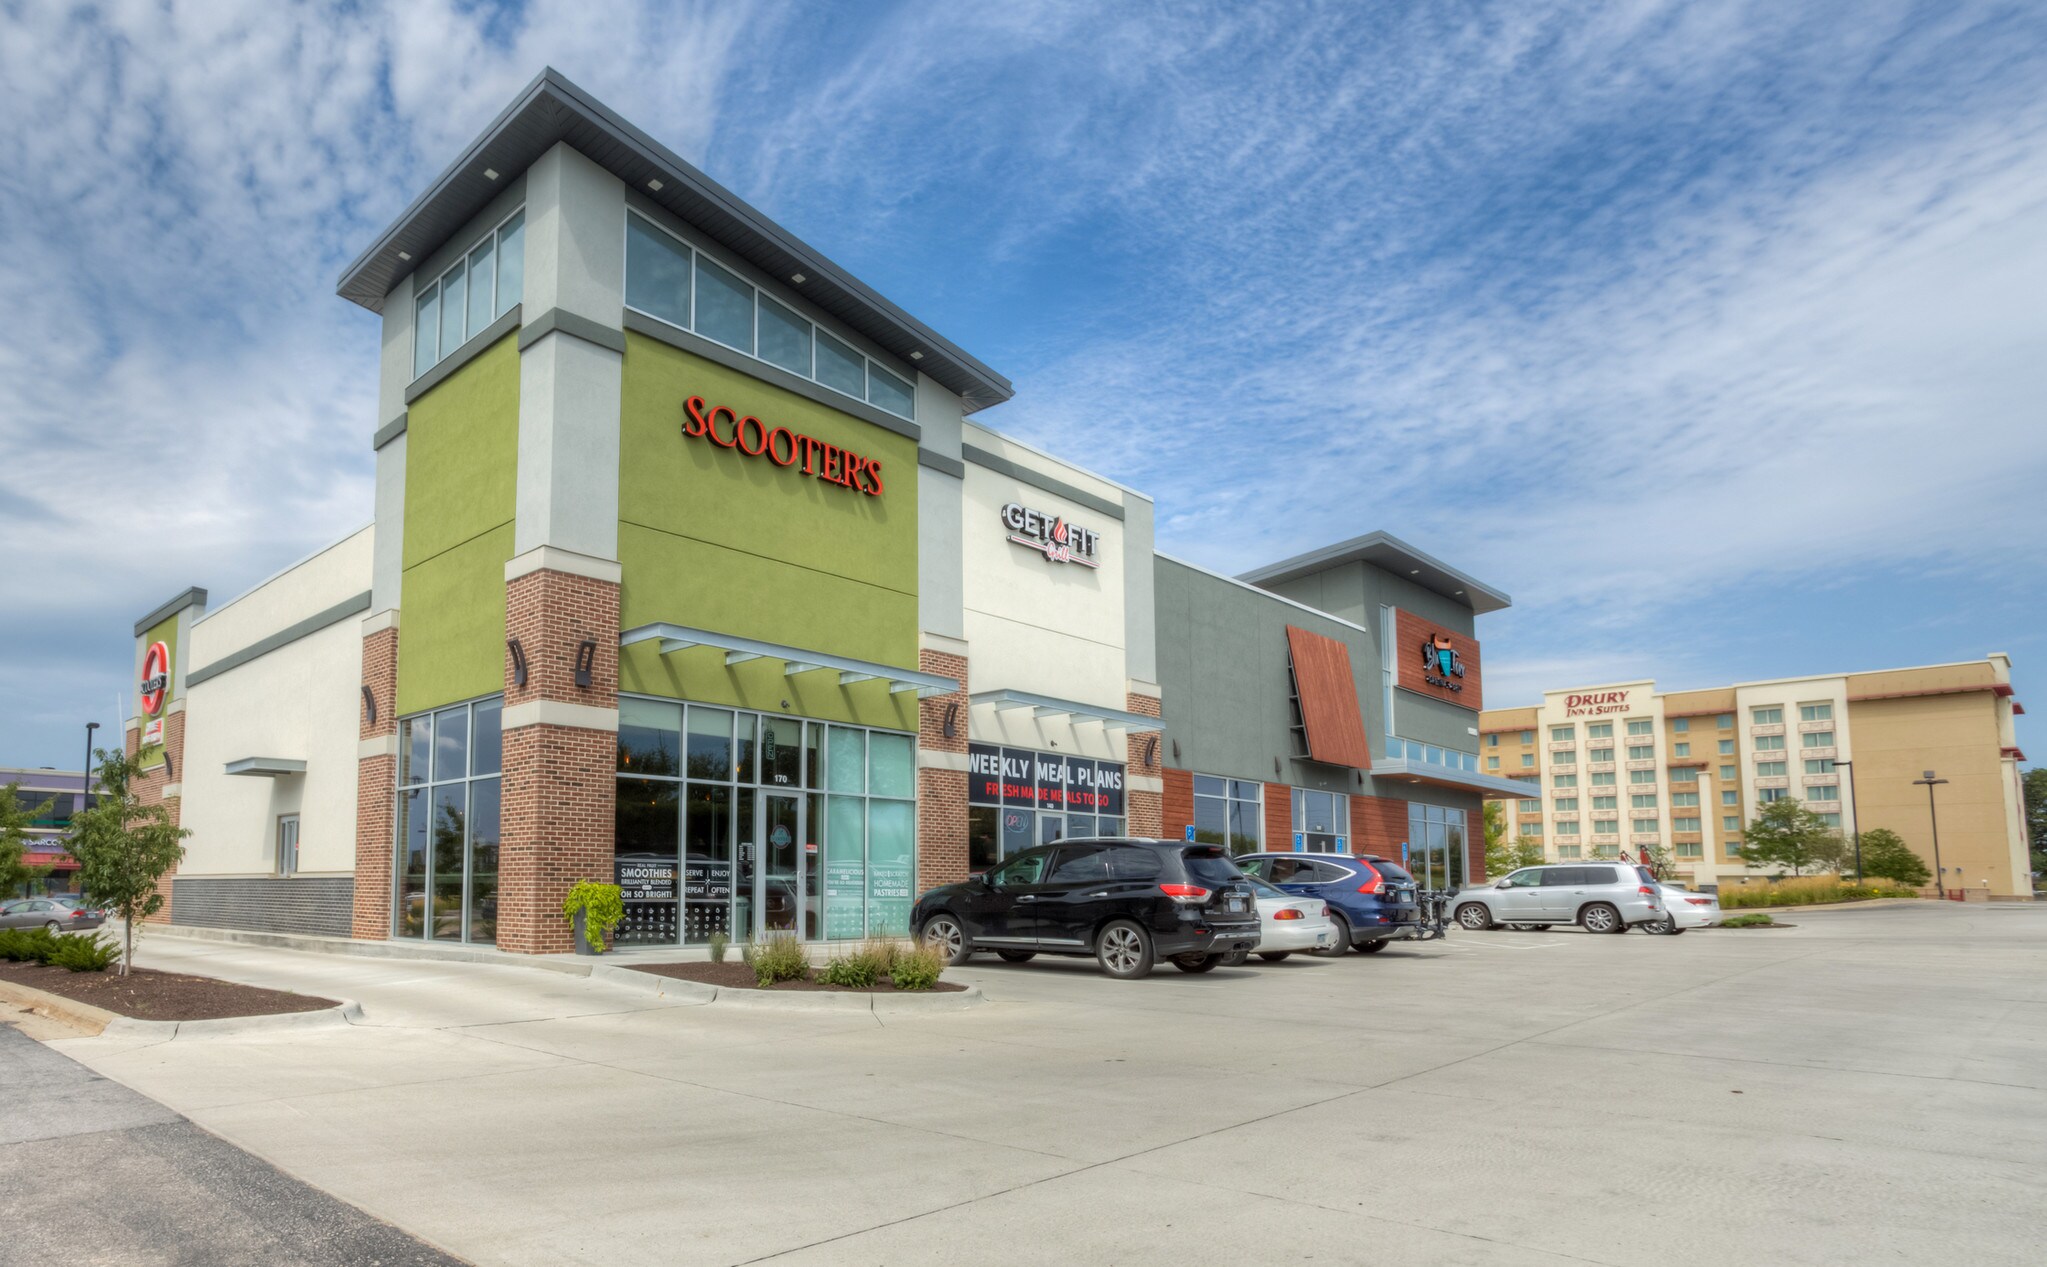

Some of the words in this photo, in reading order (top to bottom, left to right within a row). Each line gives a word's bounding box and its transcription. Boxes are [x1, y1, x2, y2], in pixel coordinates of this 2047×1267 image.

[682, 395, 884, 497] SCOOTER'S
[1001, 503, 1054, 540] GET
[1065, 523, 1100, 556] FIT
[1564, 690, 1630, 708] DRURY
[1566, 708, 1586, 718] INN
[1588, 707, 1594, 715] &
[1595, 704, 1630, 715] SUITES
[969, 753, 1029, 778] WEEKLY
[1037, 761, 1074, 785] MEAL
[1077, 767, 1122, 790] PLANS
[774, 774, 788, 783] 170
[985, 781, 1019, 797] FRESH
[1020, 785, 1048, 801] MADE
[1050, 788, 1082, 805] MEALS
[1083, 792, 1094, 805] TO
[1097, 793, 1109, 807] GO
[621, 868, 672, 878] SMOOTHIES
[711, 869, 730, 877] ENJOY
[874, 879, 909, 888] HOMEMADE
[621, 890, 632, 898] OH
[633, 890, 644, 898] SO
[645, 890, 672, 898] BRIGHT!
[711, 886, 730, 894] OFTEN
[874, 889, 899, 897] PASTRIES
